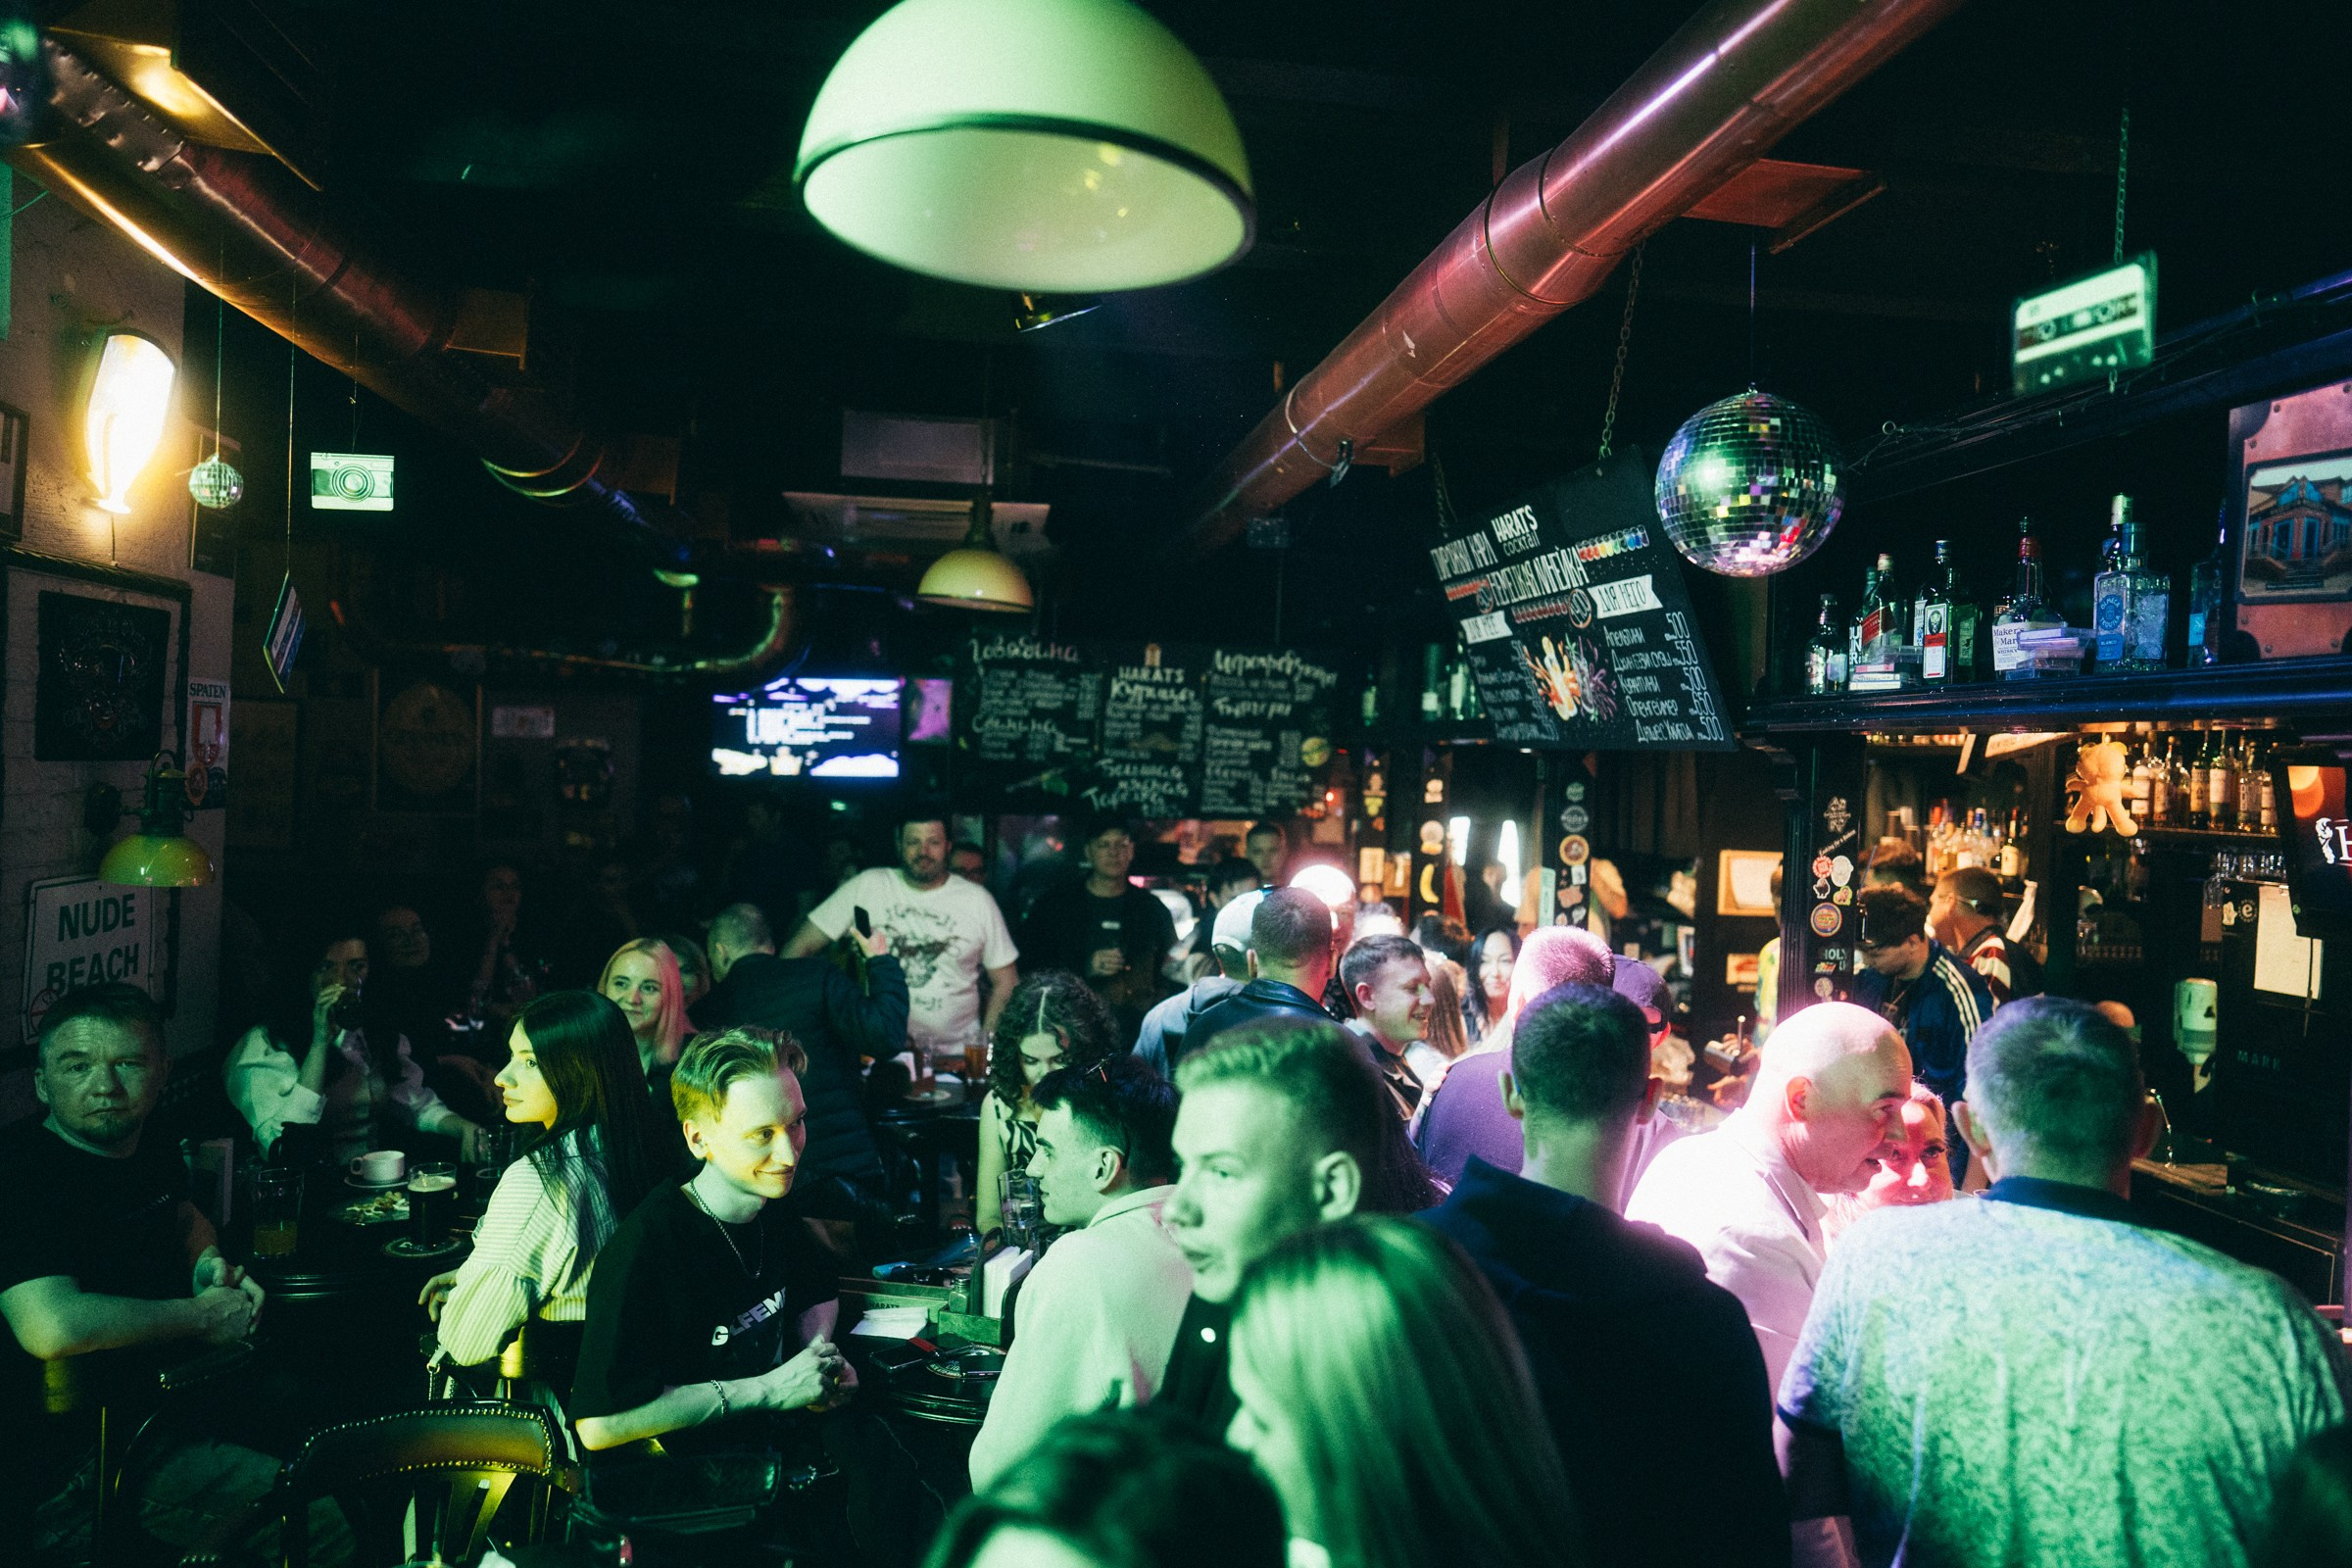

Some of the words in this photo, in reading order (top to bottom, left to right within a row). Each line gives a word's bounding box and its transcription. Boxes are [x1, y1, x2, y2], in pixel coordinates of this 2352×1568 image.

[1491, 505, 1539, 543] HARATS
[1502, 530, 1542, 557] cocktail
[1675, 640, 1698, 665] 550
[189, 683, 226, 698] SPATEN
[1683, 666, 1706, 691] 500
[1699, 716, 1724, 741] 500
[58, 893, 135, 942] NUDE
[46, 943, 139, 994] BEACH
